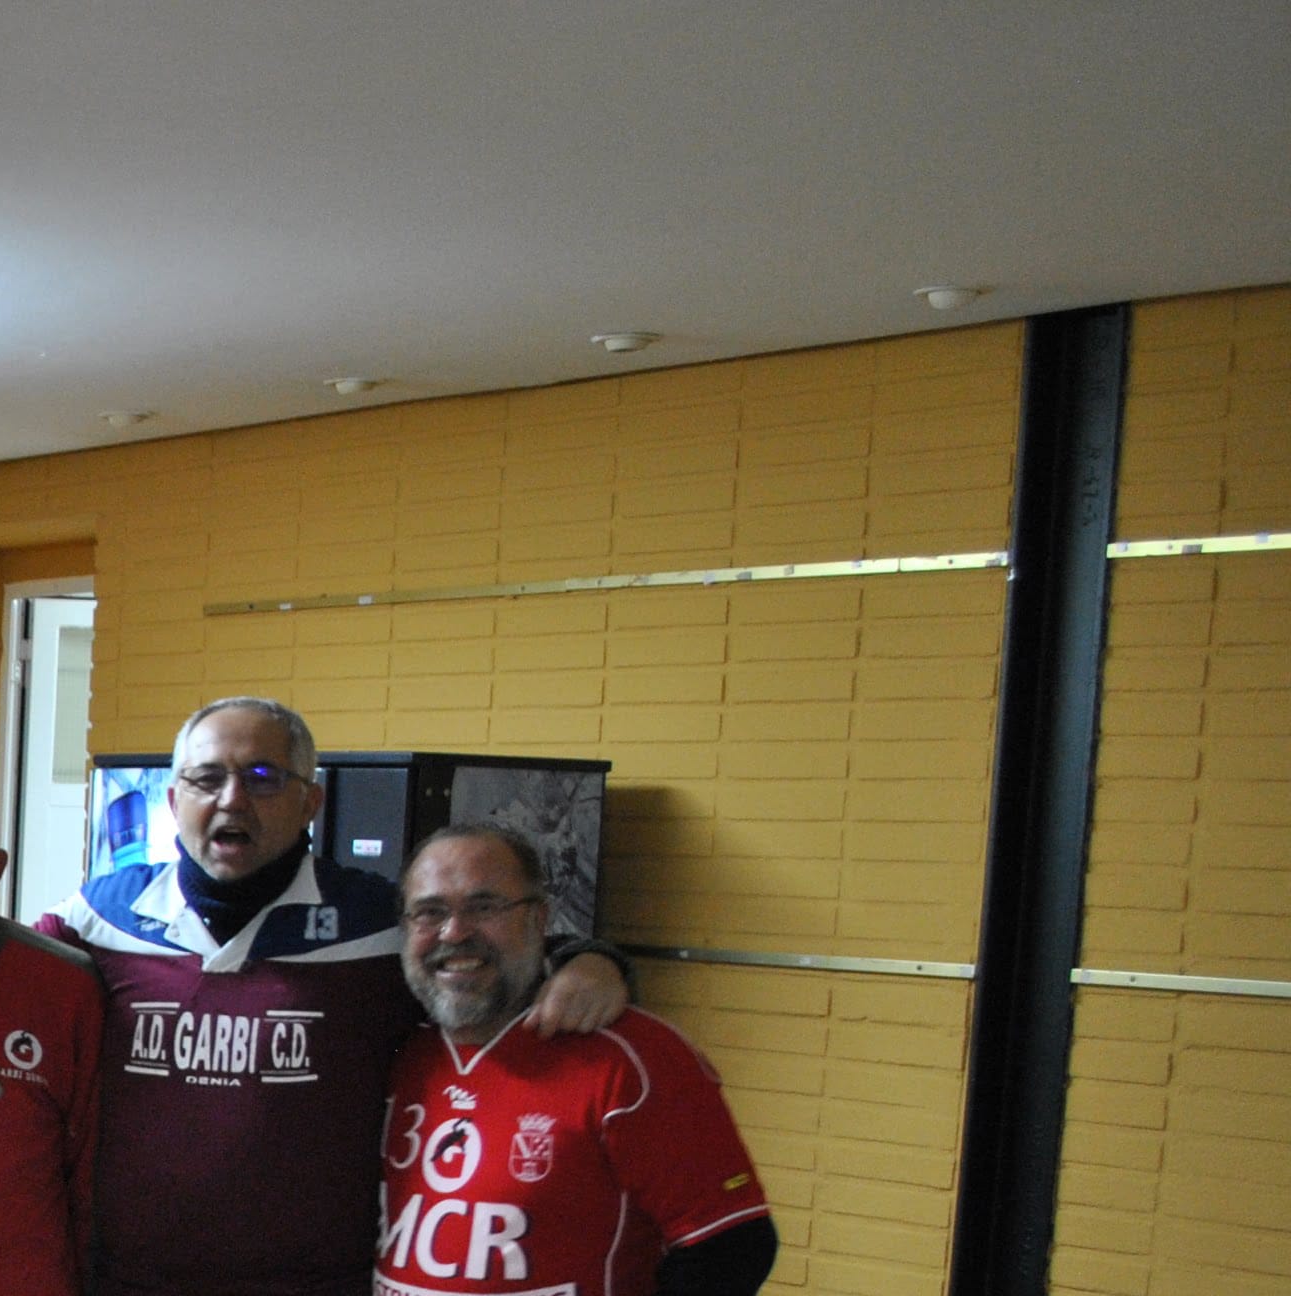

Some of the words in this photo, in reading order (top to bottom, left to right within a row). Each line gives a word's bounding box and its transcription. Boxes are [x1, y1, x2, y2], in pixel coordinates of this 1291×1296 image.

[305, 905, 338, 940] 13
[131, 1013, 166, 1061] A.D.
[173, 1011, 260, 1074] GARBI
[271, 1022, 310, 1069] C.D.
[380, 1096, 425, 1169] 13
[378, 1181, 528, 1280] MCR
